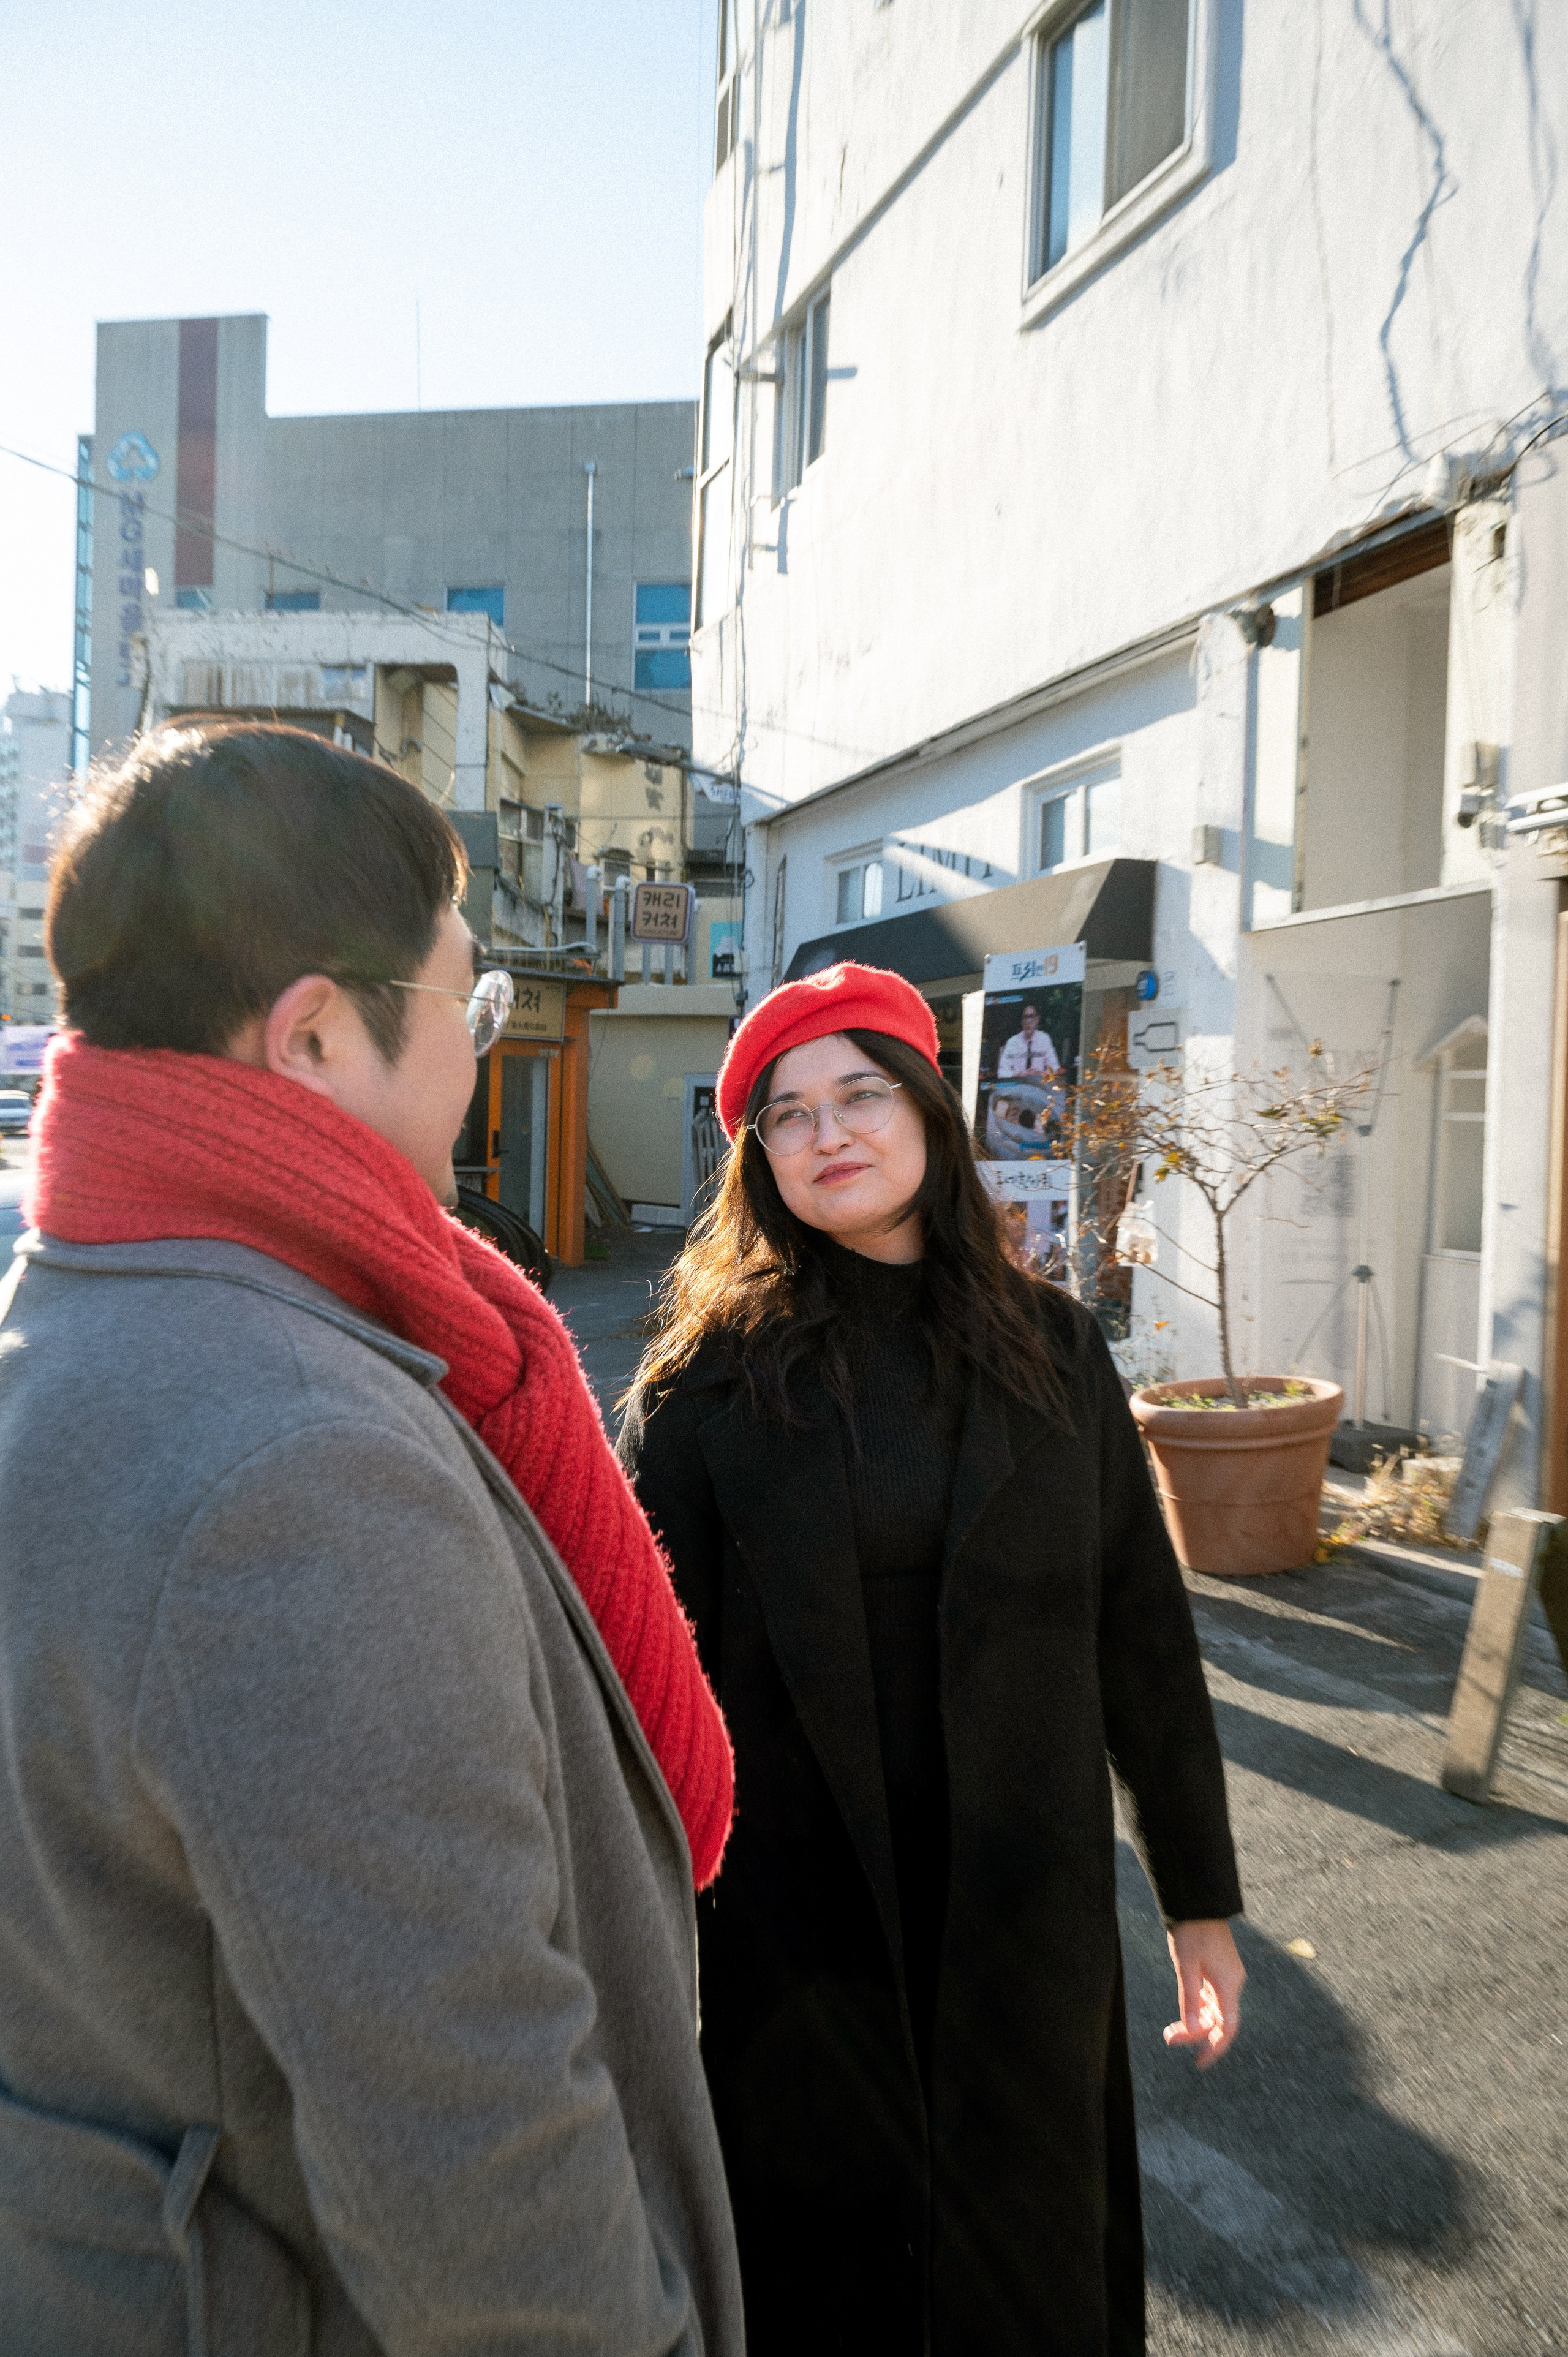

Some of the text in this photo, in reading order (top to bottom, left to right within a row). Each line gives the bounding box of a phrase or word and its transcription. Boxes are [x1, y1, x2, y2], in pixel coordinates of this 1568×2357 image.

[896, 842, 993, 903] LIMI
[642, 890, 681, 908] 캐리
[641, 911, 677, 929] 커처
